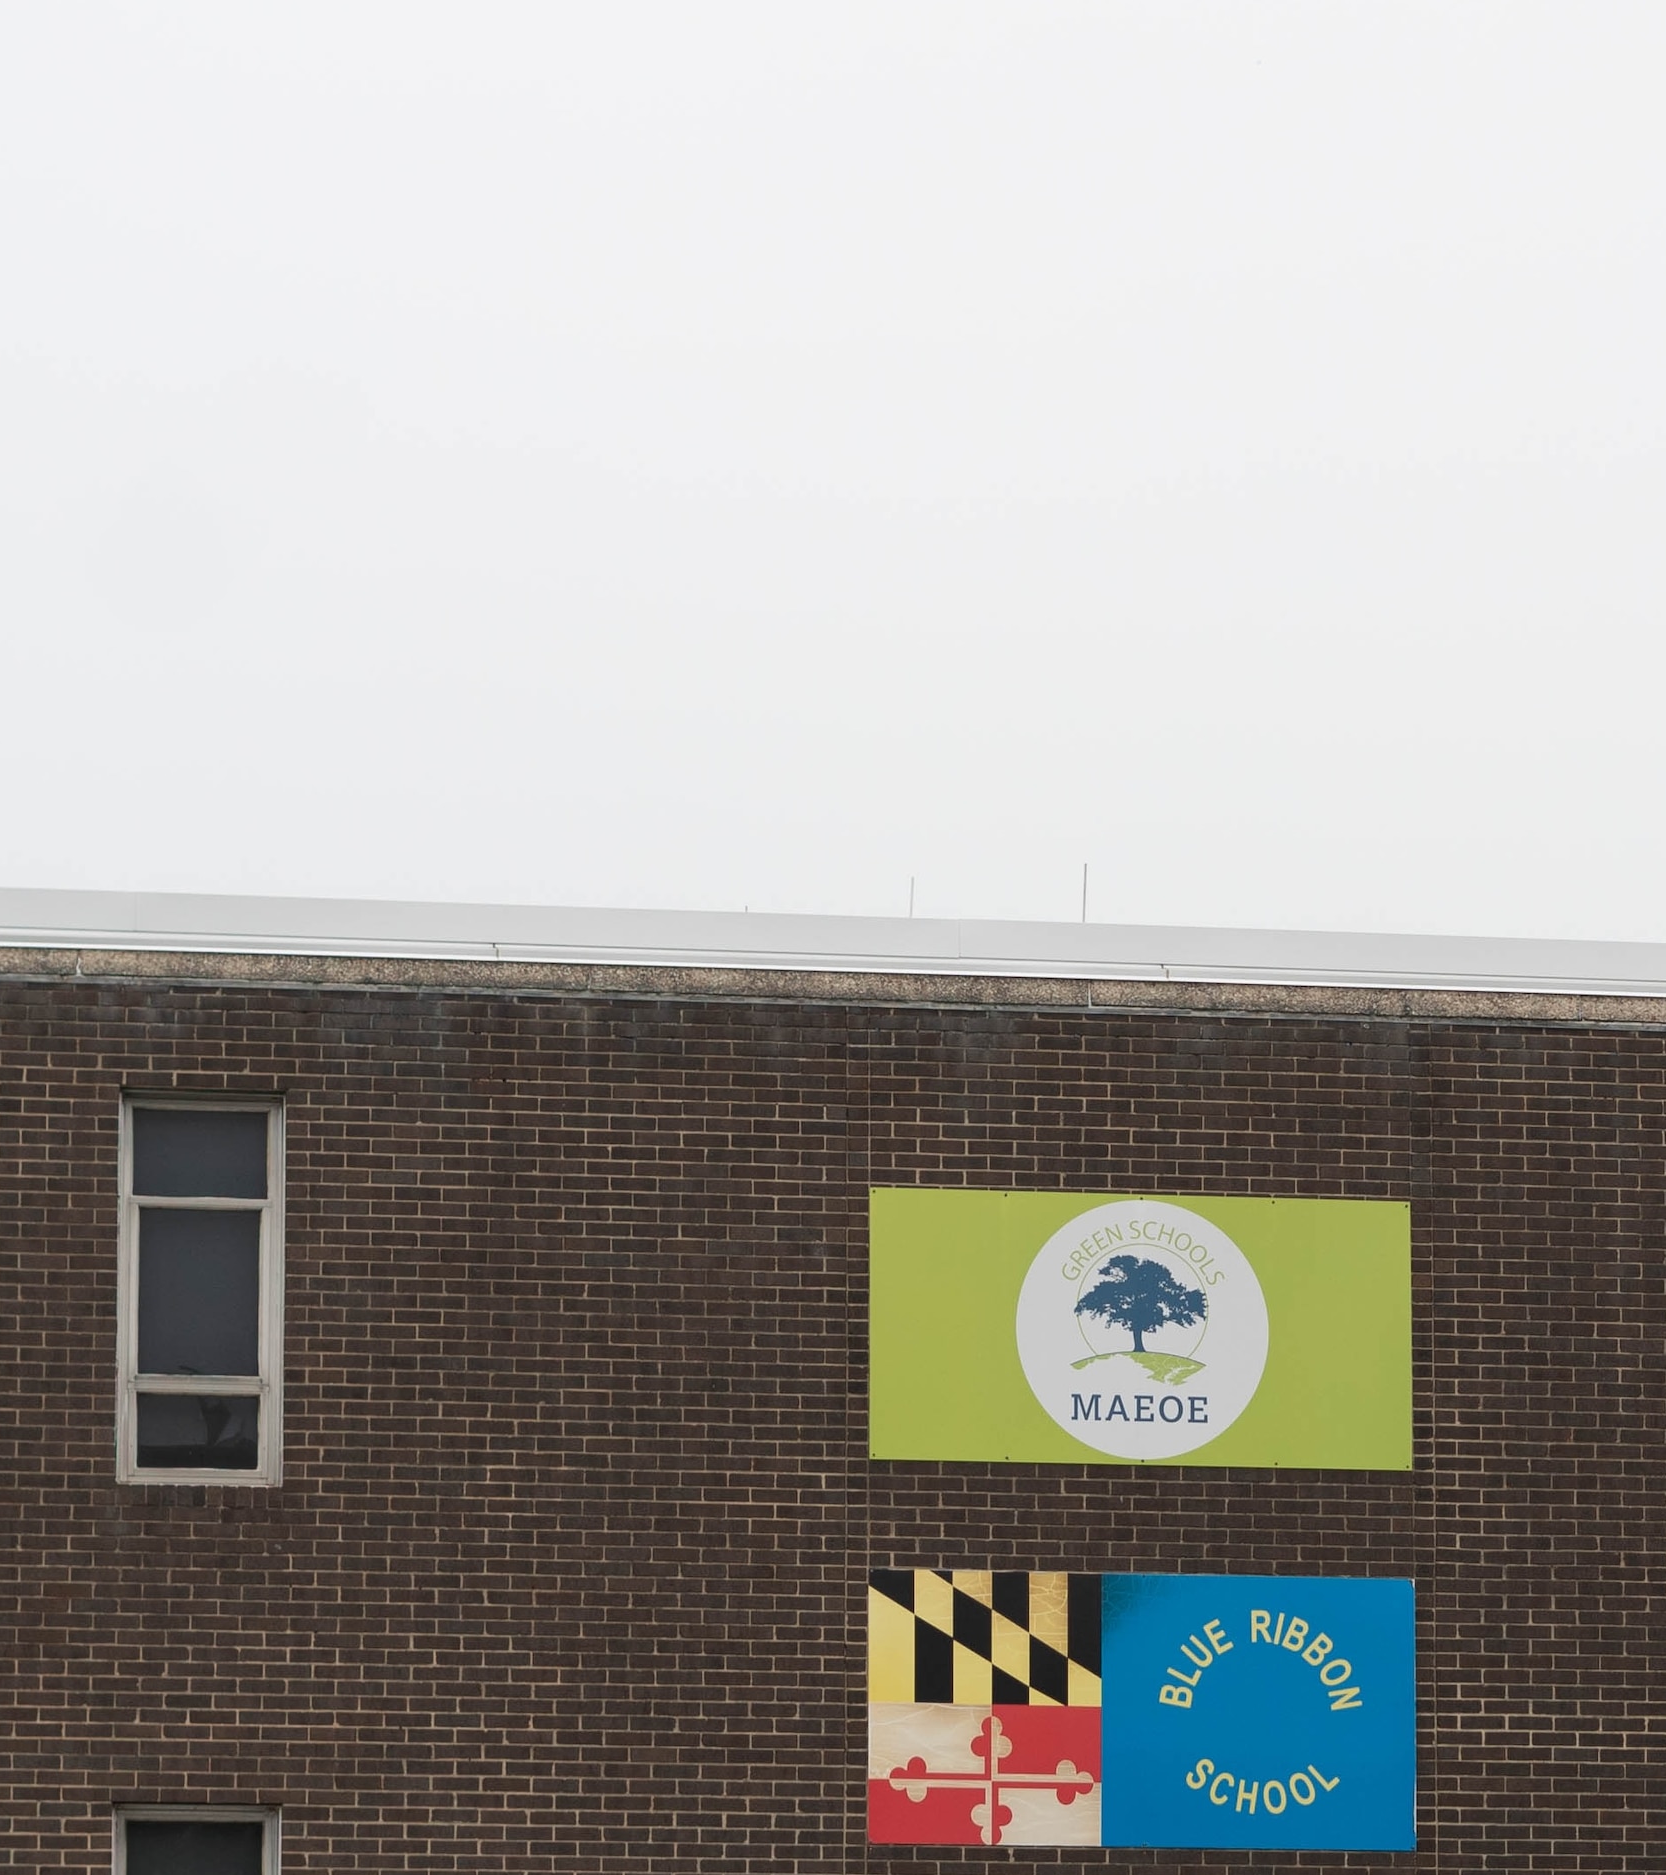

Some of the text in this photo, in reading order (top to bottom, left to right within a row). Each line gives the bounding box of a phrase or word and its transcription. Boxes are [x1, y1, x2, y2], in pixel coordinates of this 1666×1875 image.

[1060, 1220, 1226, 1287] GREEN SCHOOLS
[1071, 1393, 1210, 1424] MAEOE
[1159, 1609, 1363, 1712] BLUE RIBBON
[1186, 1758, 1340, 1815] SCHOOL
